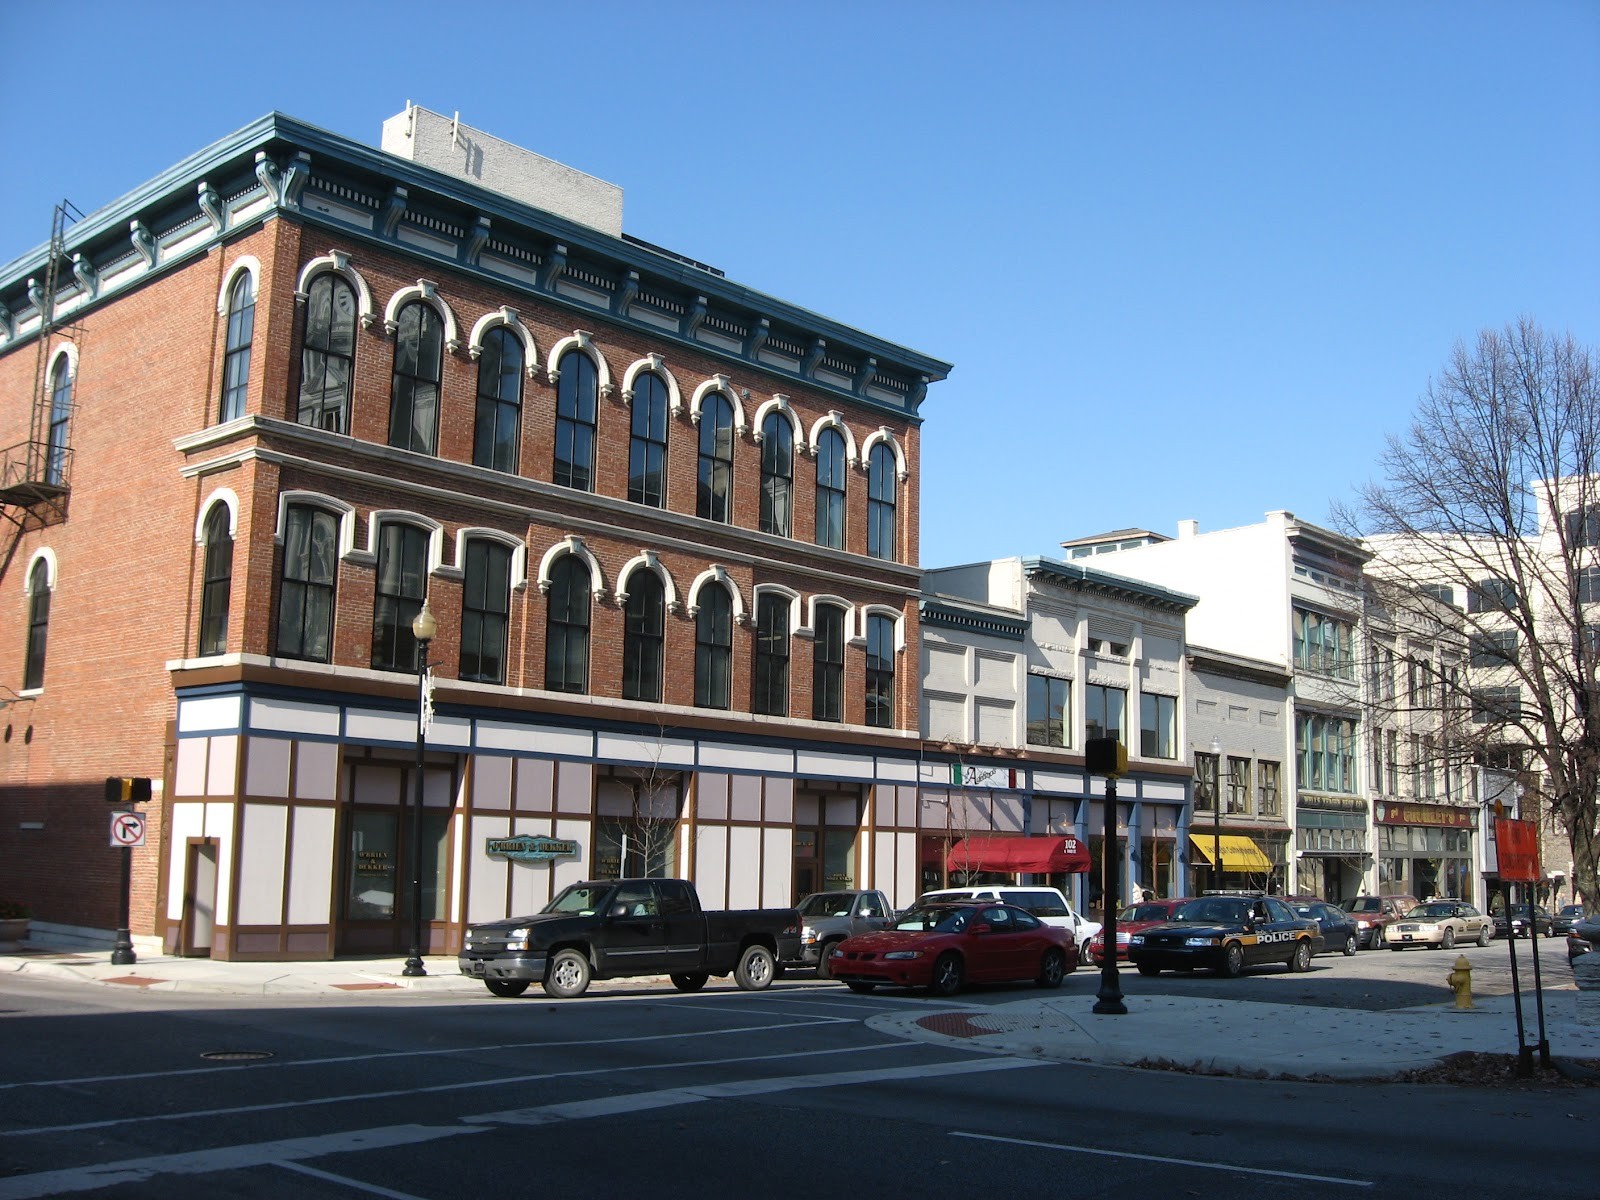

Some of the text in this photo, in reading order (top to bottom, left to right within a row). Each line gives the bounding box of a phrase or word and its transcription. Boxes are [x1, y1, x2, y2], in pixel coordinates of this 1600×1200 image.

[492, 842, 527, 852] O'BRIEN
[1064, 839, 1077, 849] 102
[1256, 932, 1296, 945] POLICE
